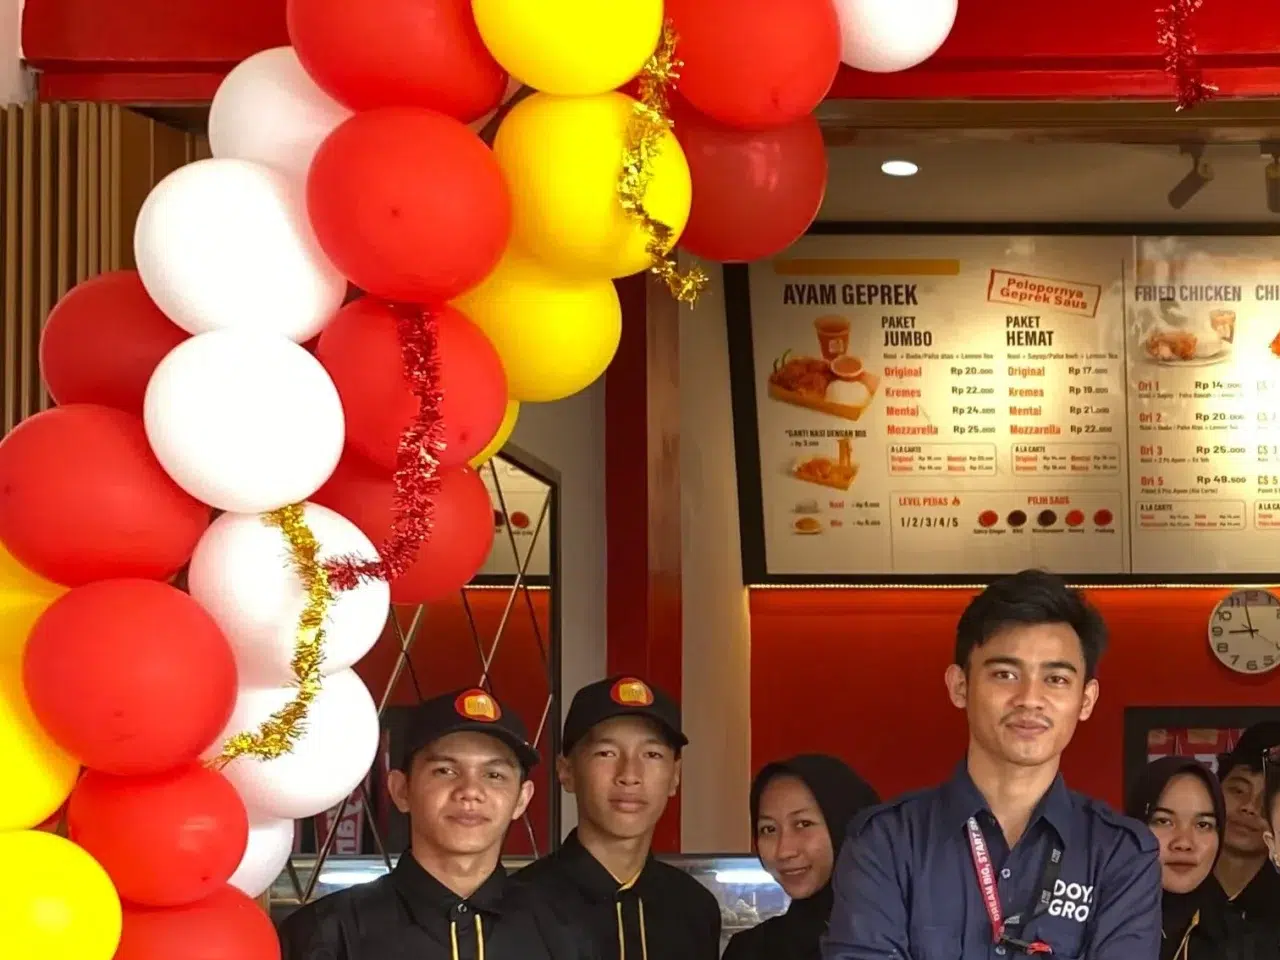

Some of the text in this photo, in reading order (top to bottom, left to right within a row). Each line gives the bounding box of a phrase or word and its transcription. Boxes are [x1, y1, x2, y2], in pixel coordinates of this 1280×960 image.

[783, 283, 918, 305] AYAM GEPREK
[1135, 285, 1242, 301] FRIED CHICKEN
[1000, 287, 1088, 310] Geprek Saus
[881, 316, 916, 329] PAKET
[1006, 316, 1040, 329] PAKET
[883, 330, 933, 347] JUMBO
[1006, 330, 1054, 346] HEMAT
[950, 367, 963, 376] Rp
[1068, 366, 1081, 376] Rp
[952, 386, 964, 396] Rp
[1069, 386, 1081, 395] Rp
[1195, 381, 1209, 391] Rp
[952, 406, 965, 416] Rp
[1070, 406, 1082, 415] Rp
[1195, 413, 1210, 422] Rp
[953, 425, 966, 435] Rp
[1070, 425, 1082, 435] Rp
[1196, 445, 1210, 455] Rp
[1197, 475, 1211, 485] Rp
[1257, 475, 1269, 485] CS
[1217, 610, 1232, 621] 10
[1212, 626, 1223, 636] 9
[1217, 642, 1228, 653] 8
[1230, 654, 1240, 665] 7
[1263, 655, 1274, 666] 5
[1246, 660, 1258, 670] 6
[972, 832, 988, 863] START
[1053, 879, 1093, 904] DOY
[984, 886, 1000, 922] DREAM
